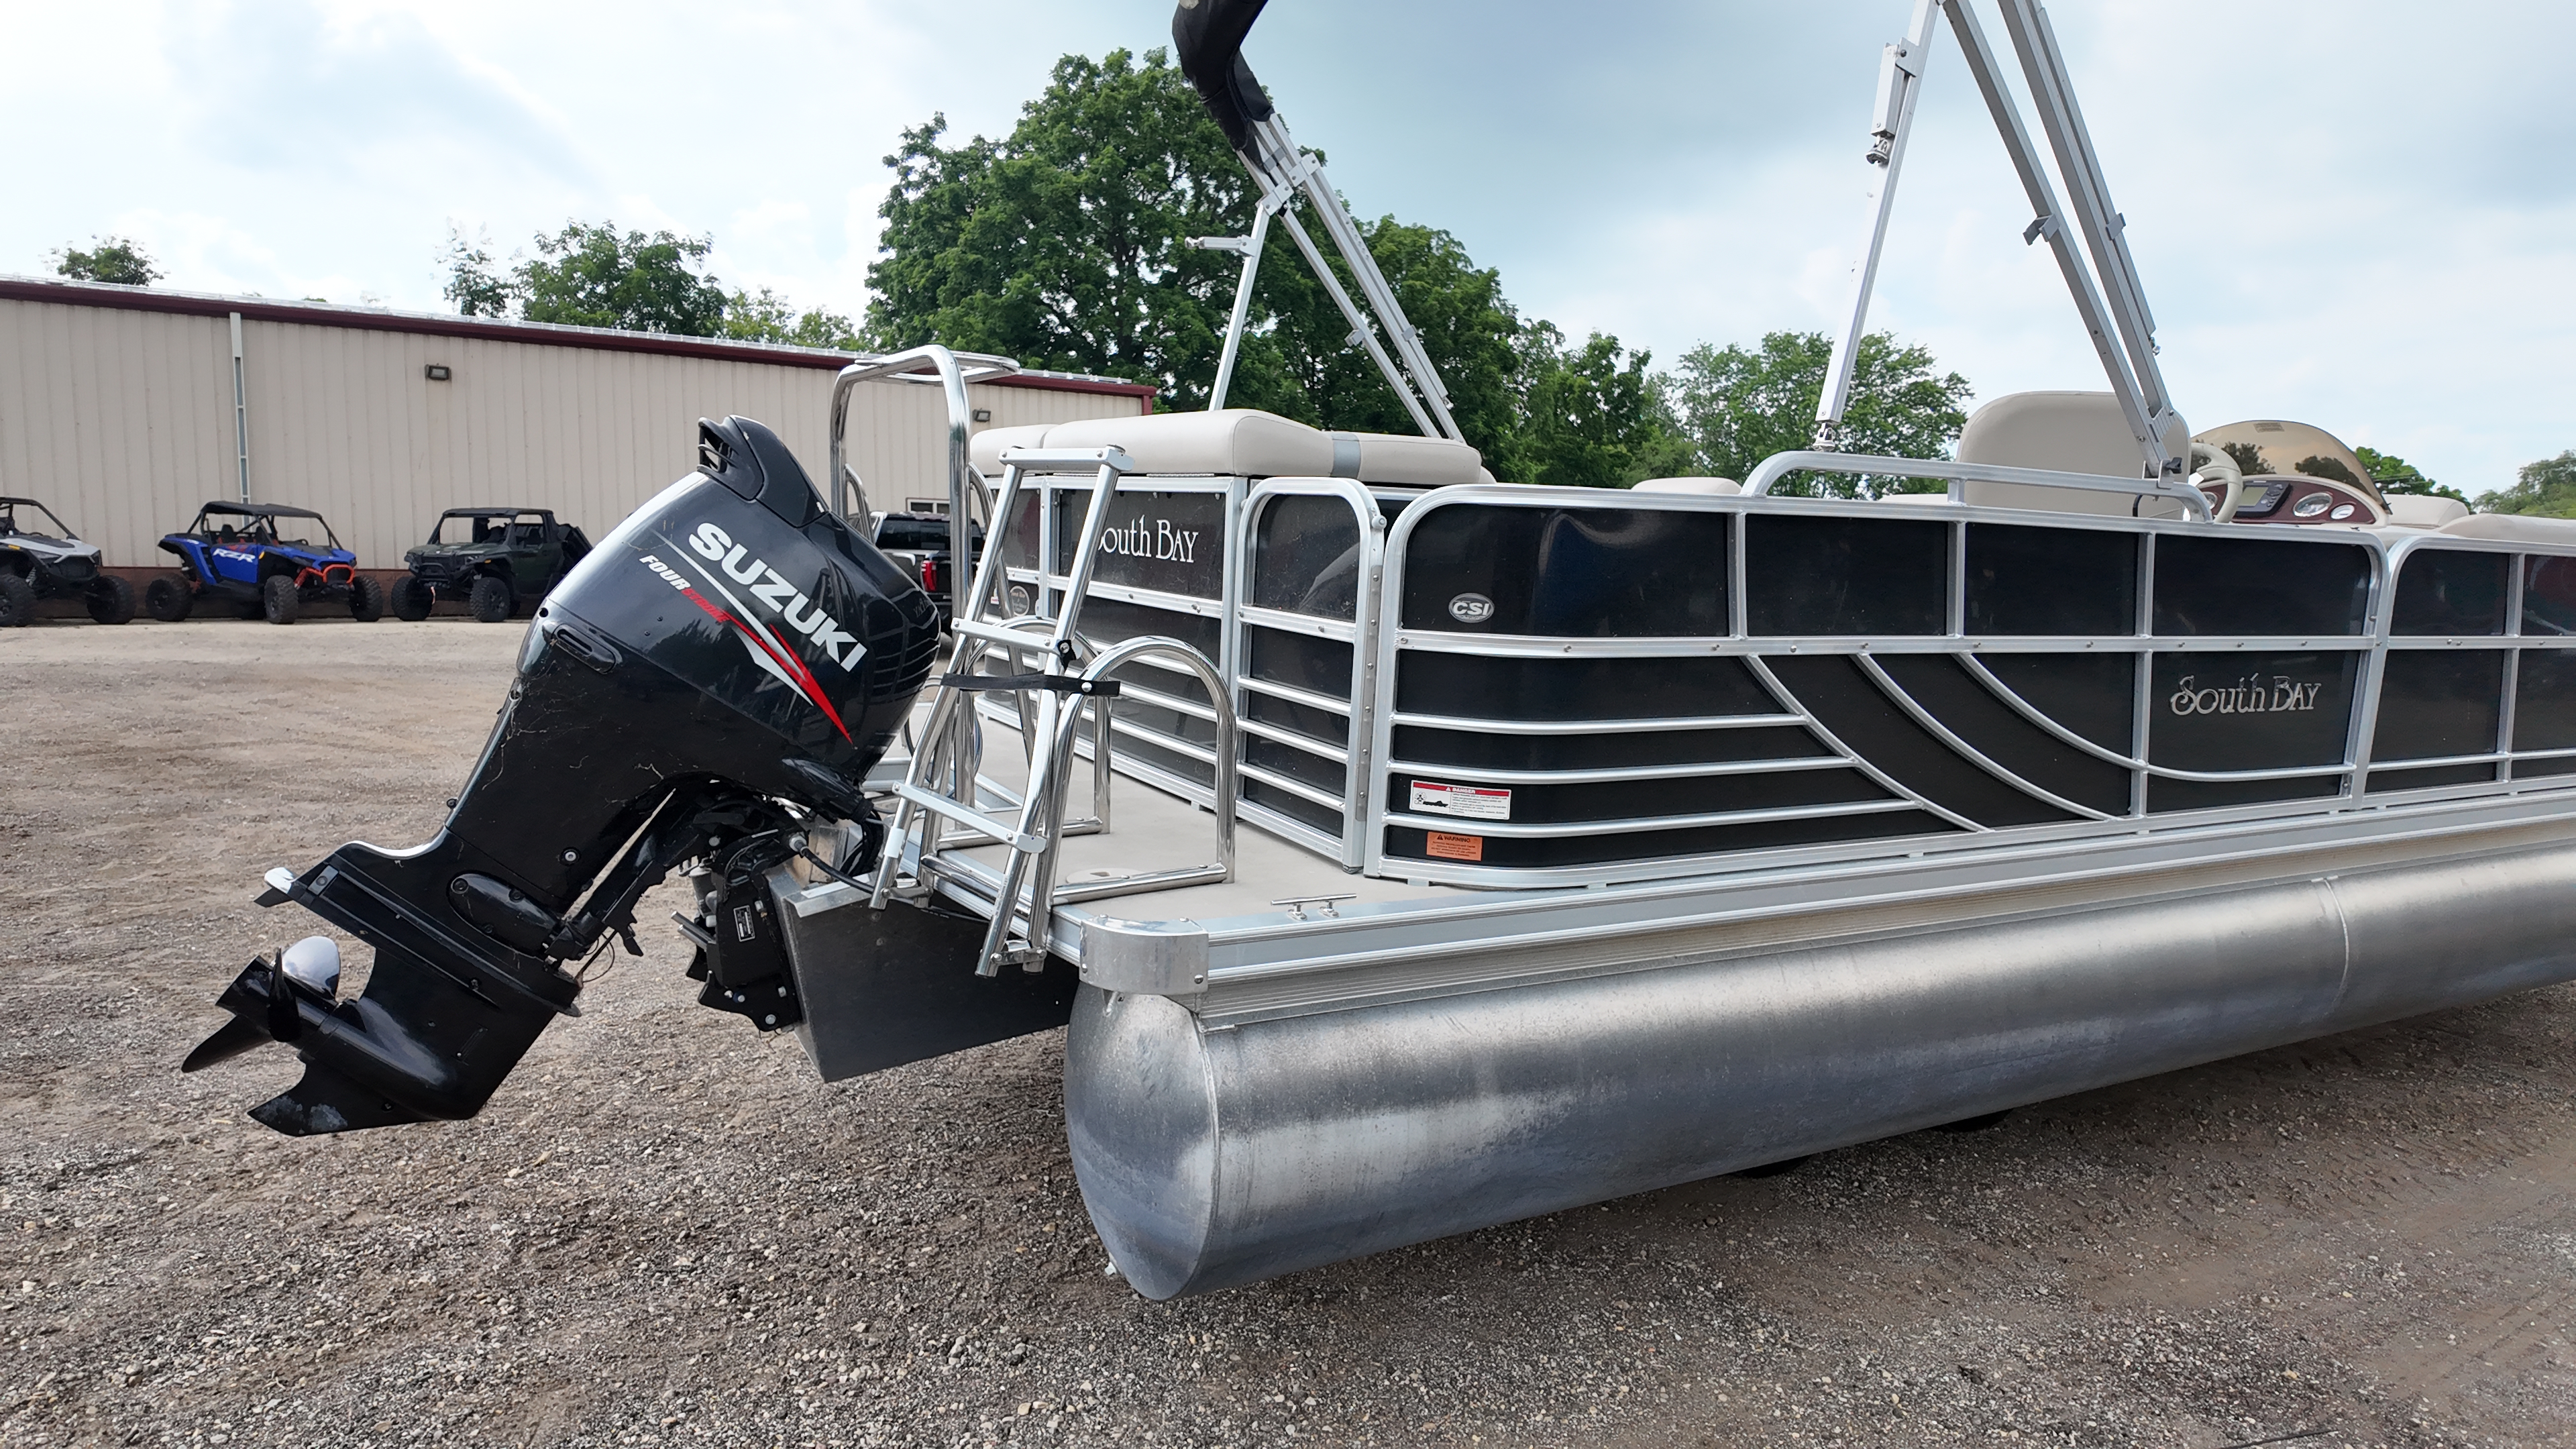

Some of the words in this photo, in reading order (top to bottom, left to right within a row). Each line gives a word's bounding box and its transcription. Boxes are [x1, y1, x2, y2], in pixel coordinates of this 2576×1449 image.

[213, 548, 256, 562] RZR
[1098, 515, 1151, 557] outh
[1156, 520, 1199, 563] BAY
[689, 523, 867, 672] SUZUKI
[1453, 602, 1490, 615] CSI
[2170, 673, 2265, 715] South
[2269, 676, 2322, 711] BAY
